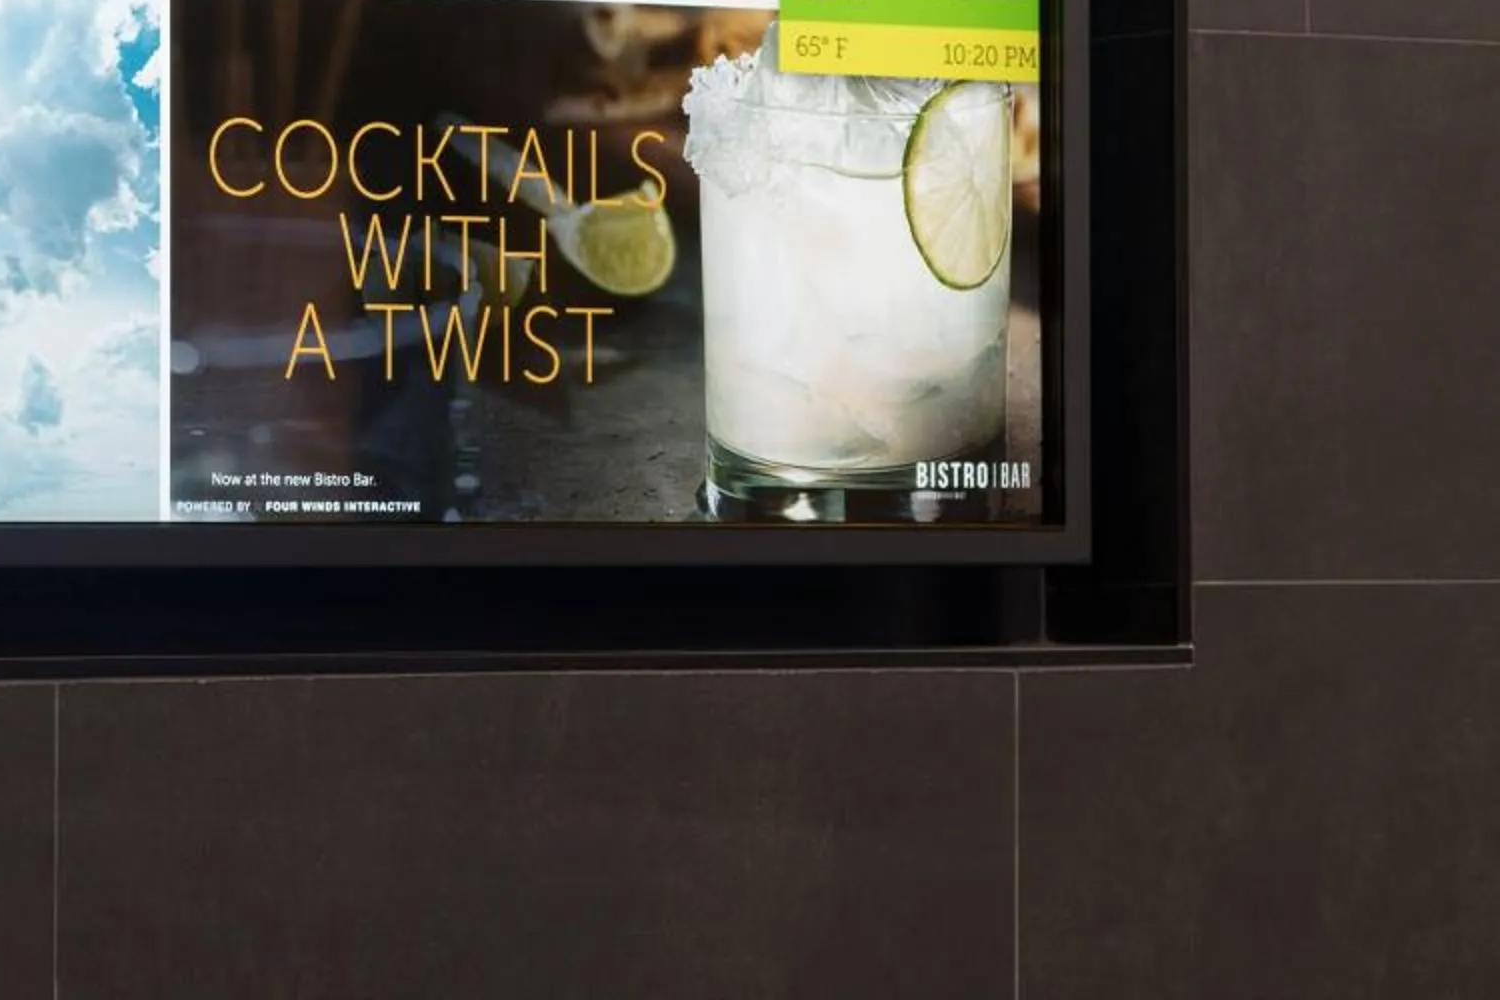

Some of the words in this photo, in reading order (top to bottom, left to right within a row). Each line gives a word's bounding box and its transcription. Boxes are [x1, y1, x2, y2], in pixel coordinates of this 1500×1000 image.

[835, 37, 849, 60] F
[943, 43, 998, 67] 10:20
[1004, 45, 1037, 69] PM
[209, 117, 668, 208] COCKTAILS
[339, 212, 547, 293] WITH
[285, 302, 336, 381] A
[364, 303, 615, 384] TWIST
[211, 472, 242, 487] Now
[244, 472, 257, 487] at
[260, 472, 281, 487] the
[284, 474, 311, 487] new
[313, 472, 350, 487] Bistro
[353, 472, 377, 488] Bar.
[915, 461, 989, 489] BISTRO
[1000, 461, 1032, 489] BAR
[265, 501, 299, 513] FOUR
[302, 501, 341, 513] WINDS
[344, 501, 422, 513] INTERACTIVE
